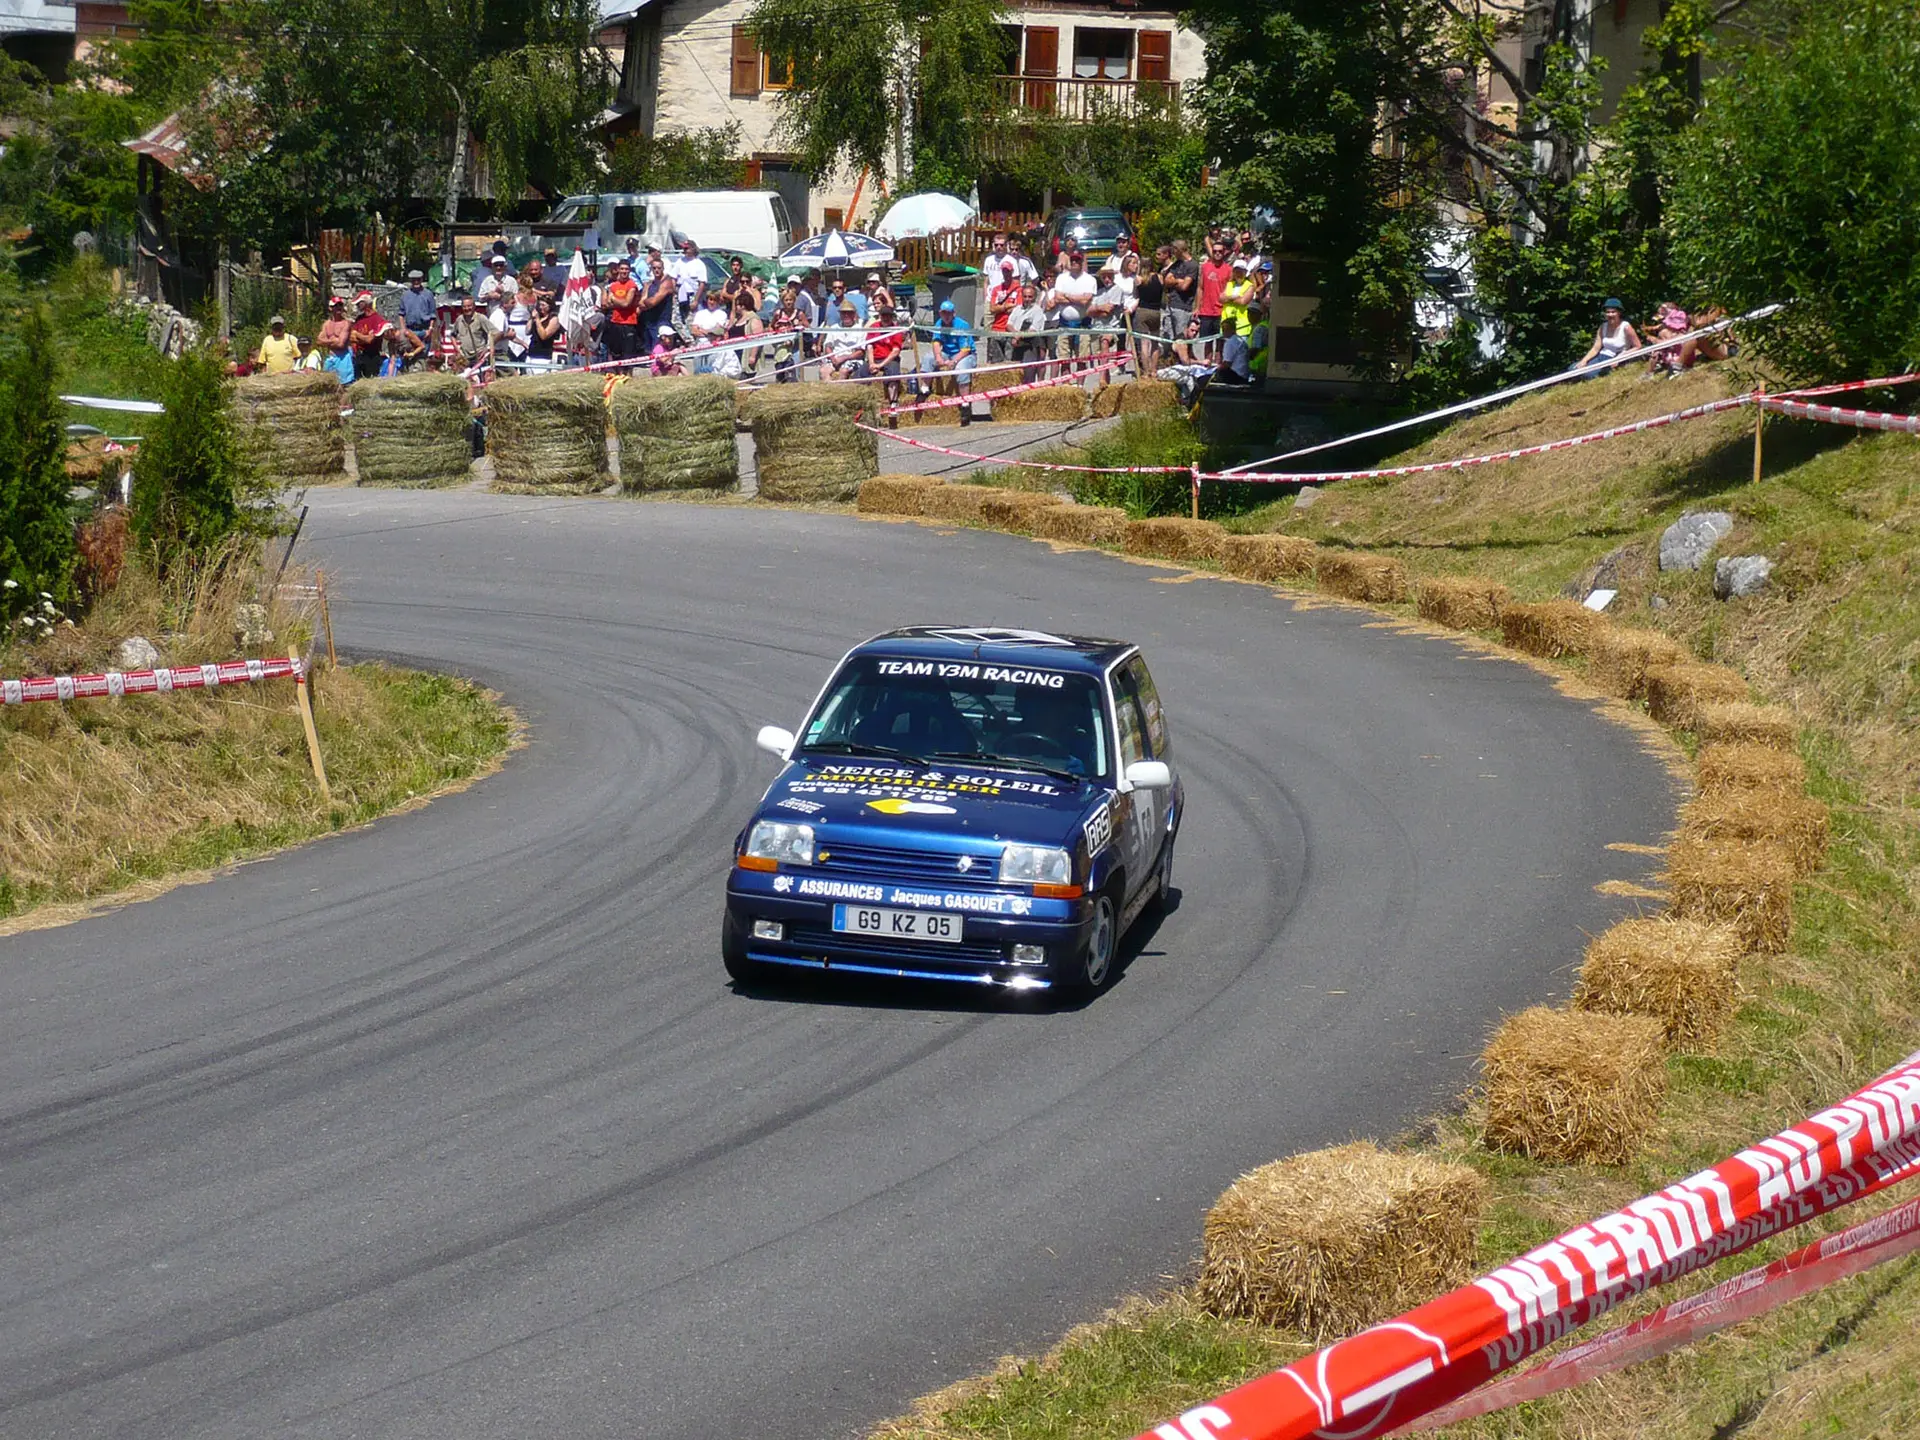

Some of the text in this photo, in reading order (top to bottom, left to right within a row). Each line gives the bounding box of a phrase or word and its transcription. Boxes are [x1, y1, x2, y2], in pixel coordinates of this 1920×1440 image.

[878, 661, 1065, 688] TEAM Y3M RACING
[788, 780, 856, 790] Embrun
[804, 773, 1001, 795] IMMOBILIER
[819, 765, 1060, 796] NEIGE & SOLEIL
[890, 791, 916, 799] 17
[799, 879, 1005, 912] ASSURANCES Jacques GASQUET
[857, 910, 951, 936] 69 KZ 05
[1473, 1168, 1736, 1333] INTERDIT
[1733, 1129, 1822, 1211] AU
[1481, 1303, 1579, 1371] VOTRE
[1813, 1167, 1866, 1207] EST
